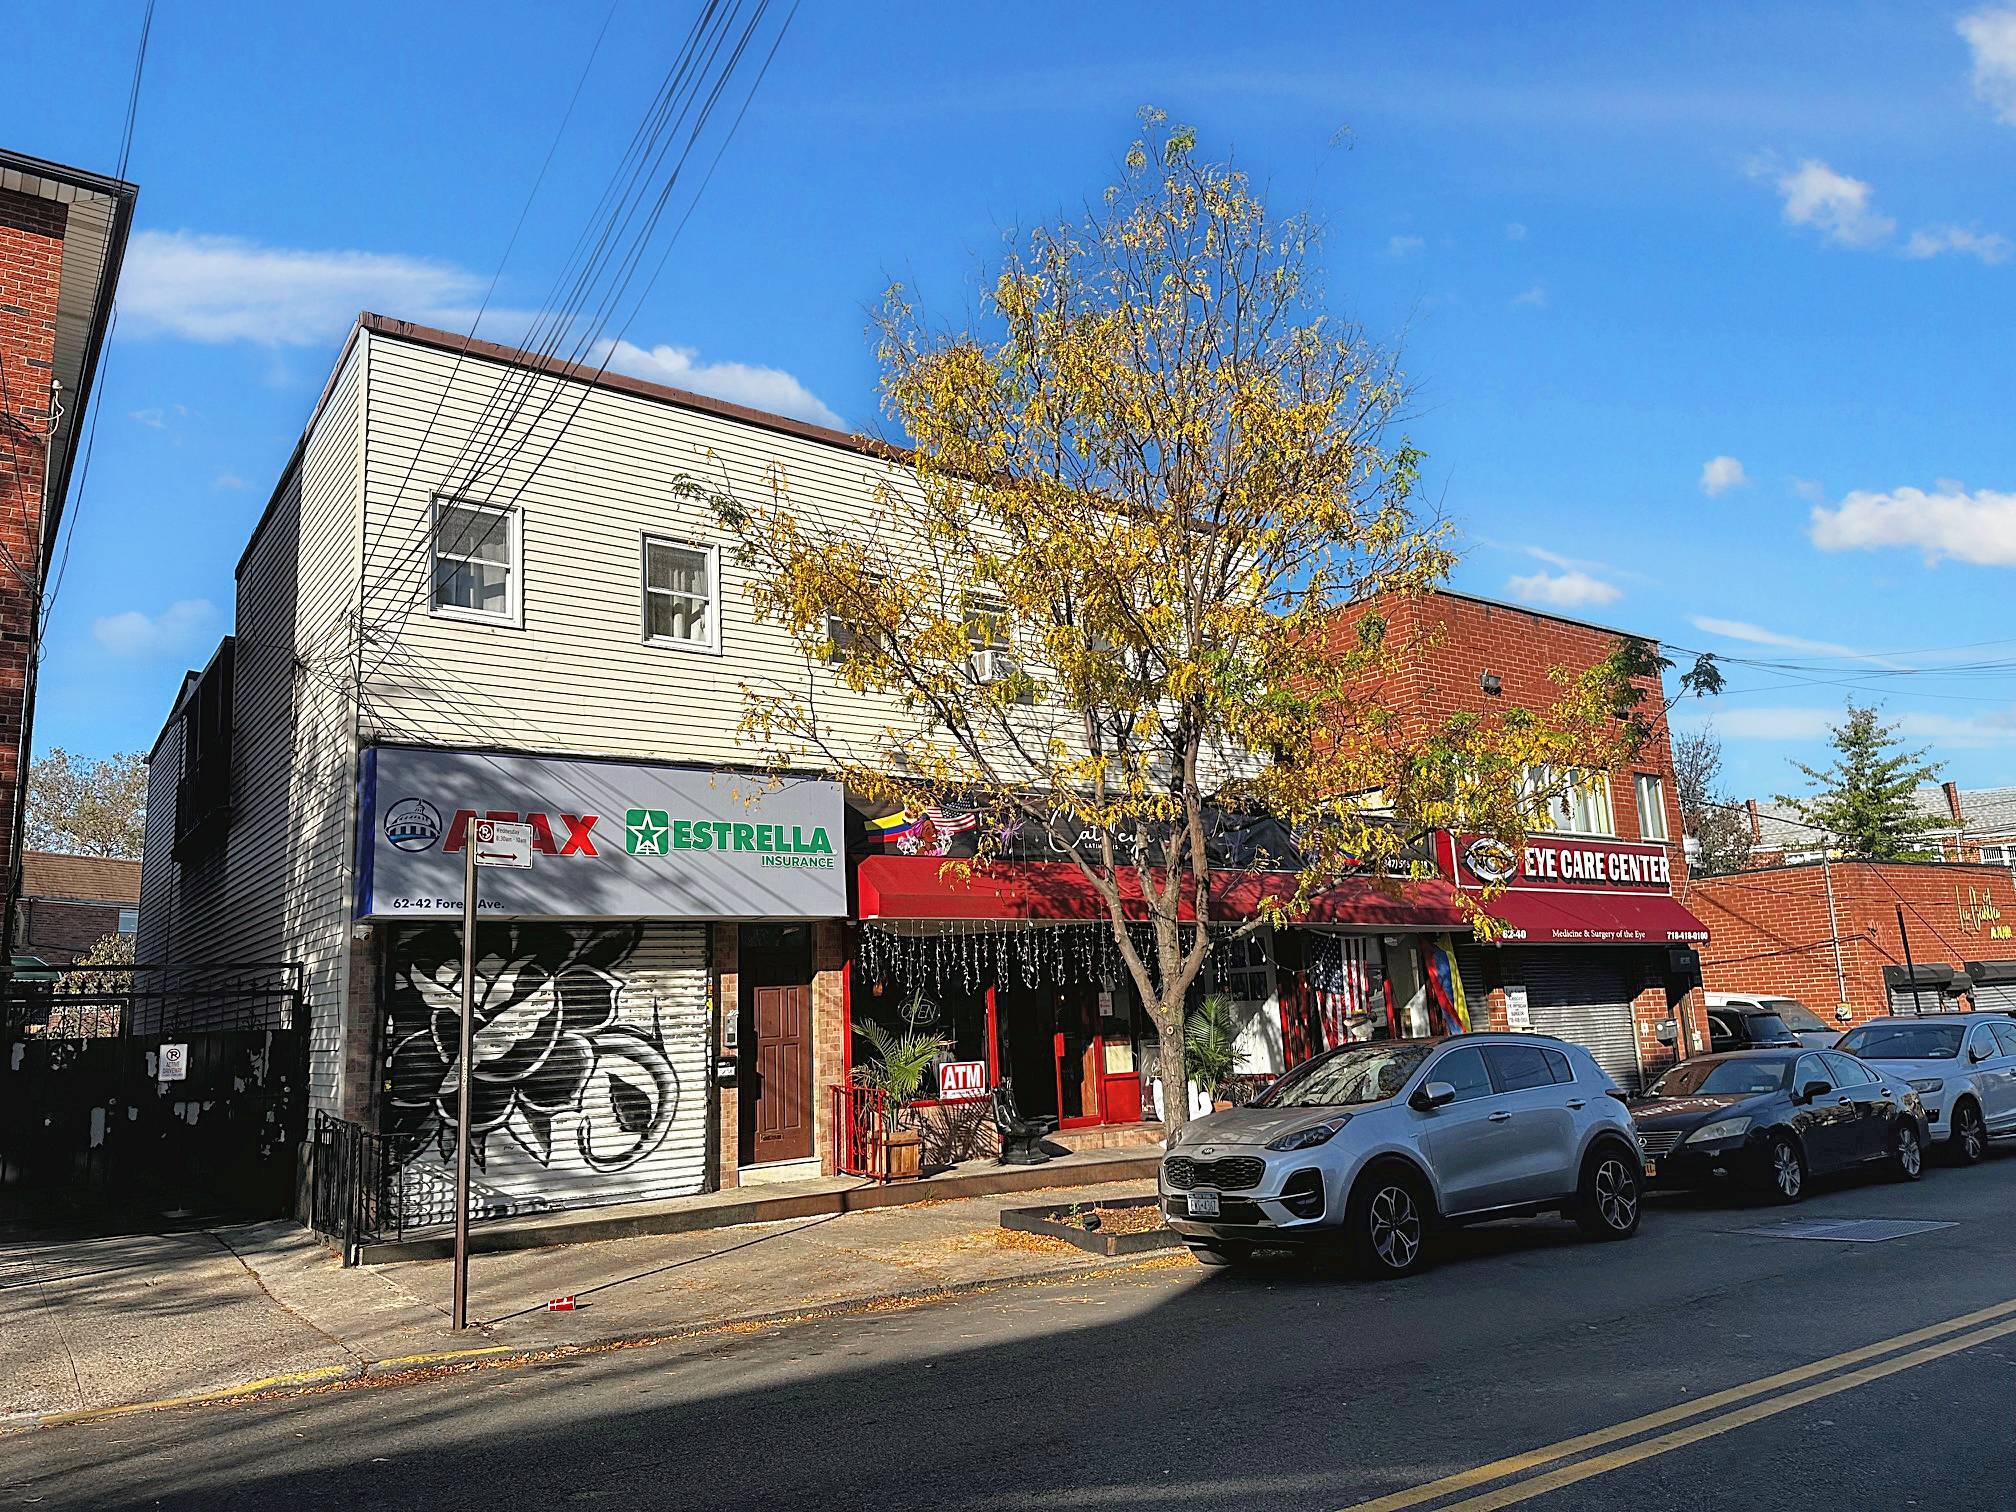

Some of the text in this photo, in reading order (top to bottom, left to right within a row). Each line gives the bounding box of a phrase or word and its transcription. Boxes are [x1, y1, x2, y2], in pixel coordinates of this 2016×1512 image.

[673, 819, 834, 854] ESTRELLA
[761, 855, 834, 869] INSURANCE
[1524, 847, 1670, 883] EYE CARE CENTER
[393, 898, 505, 909] 62-42 Fore Ave.
[1502, 930, 1527, 939] 62-40
[1552, 929, 1583, 938] Medicine
[1583, 929, 1590, 938] &
[1591, 929, 1615, 940] Surgery
[1616, 929, 1623, 938] of
[1624, 929, 1633, 938] the
[1634, 930, 1646, 940] Eye
[943, 1065, 981, 1089] ATM
